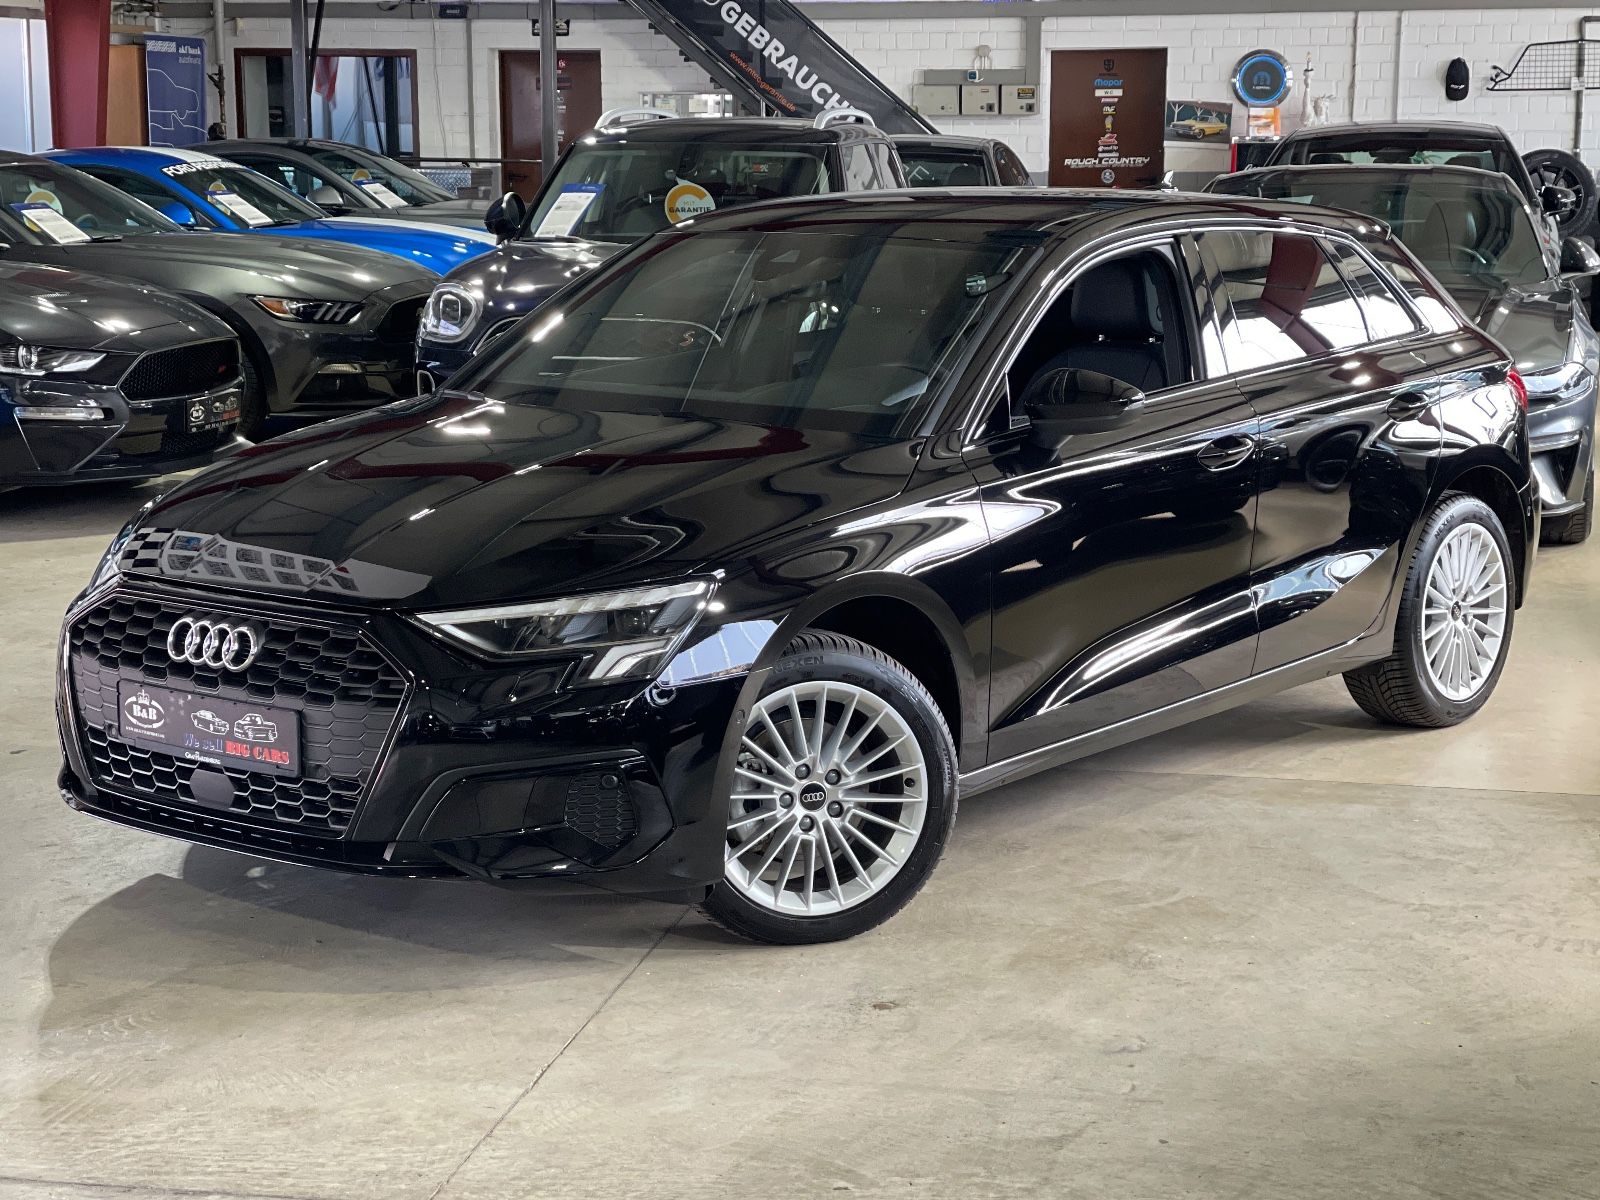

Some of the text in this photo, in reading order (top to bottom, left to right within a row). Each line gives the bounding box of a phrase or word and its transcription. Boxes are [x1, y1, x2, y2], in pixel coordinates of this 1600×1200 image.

[721, 1, 857, 122] GEBRAUCH
[161, 164, 197, 177] FORD
[1064, 158, 1099, 166] ROUGH
[1102, 157, 1151, 165] COUNTRY
[772, 655, 825, 675] NEXEN
[132, 704, 157, 721] B&B
[225, 740, 250, 757] BIG
[253, 746, 290, 765] CARS
